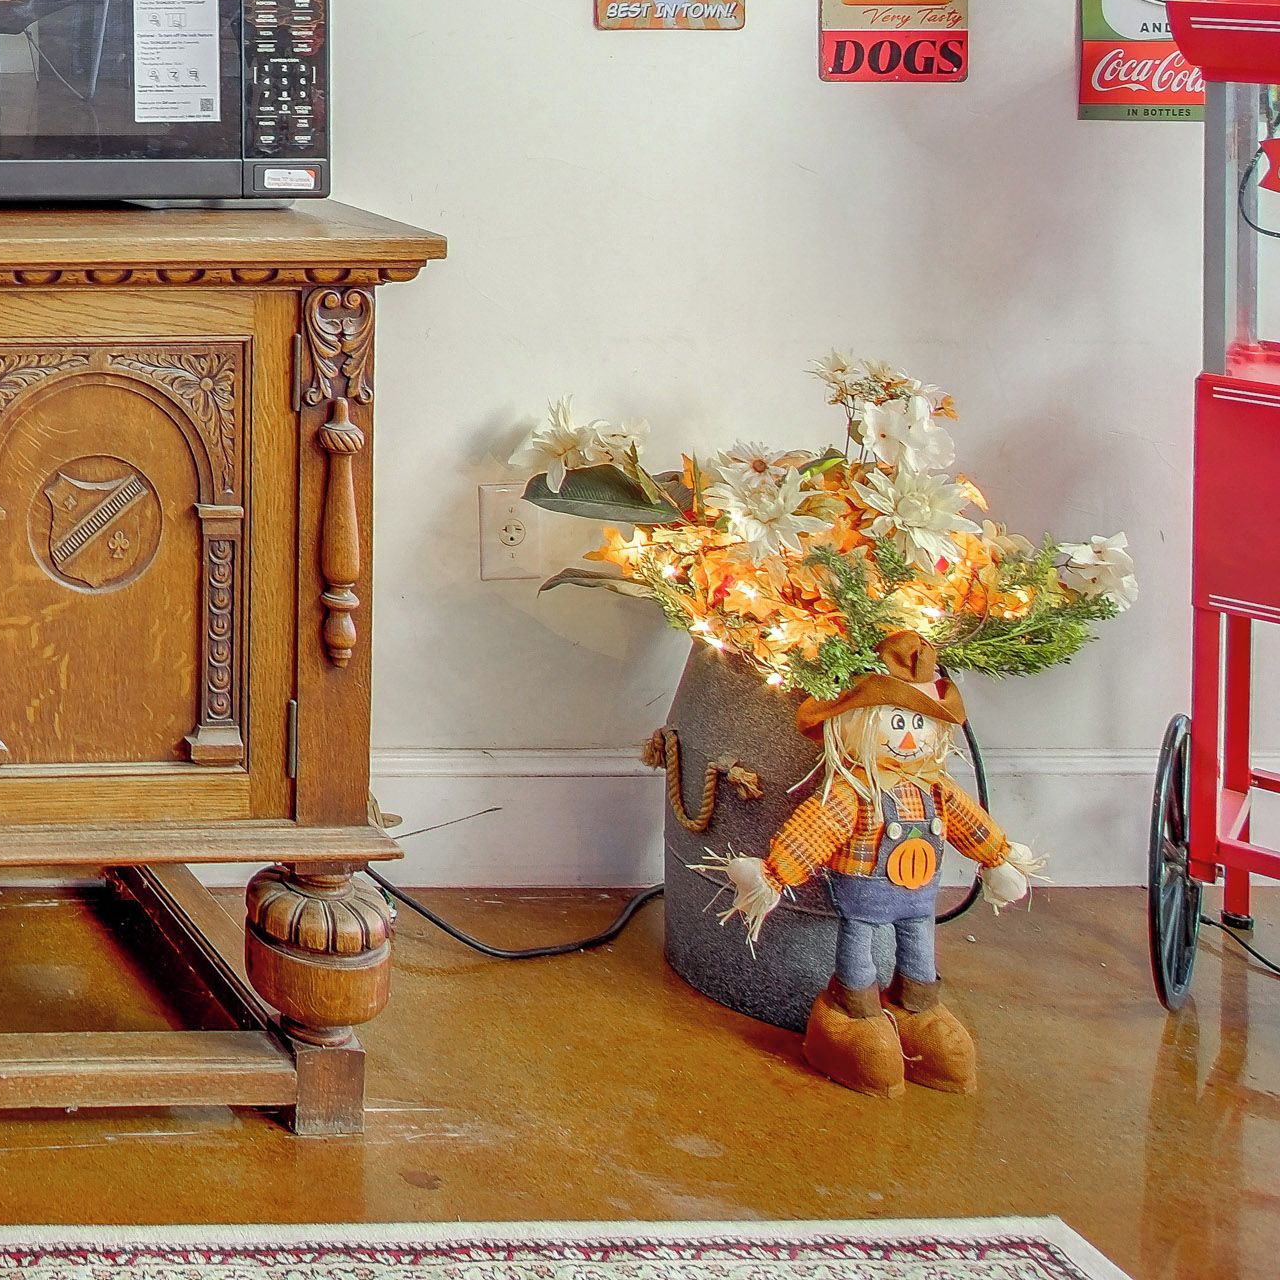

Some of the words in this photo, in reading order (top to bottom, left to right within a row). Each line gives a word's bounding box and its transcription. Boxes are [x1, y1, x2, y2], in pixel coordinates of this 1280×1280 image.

[607, 3, 652, 18] BEST
[654, 3, 677, 18] IN
[681, 2, 738, 19] TOWN!
[863, 7, 912, 29] Very
[917, 4, 964, 29] Tasty
[828, 39, 964, 75] DOGS
[1127, 108, 1140, 116] IN
[1143, 107, 1192, 117] BOTTLES
